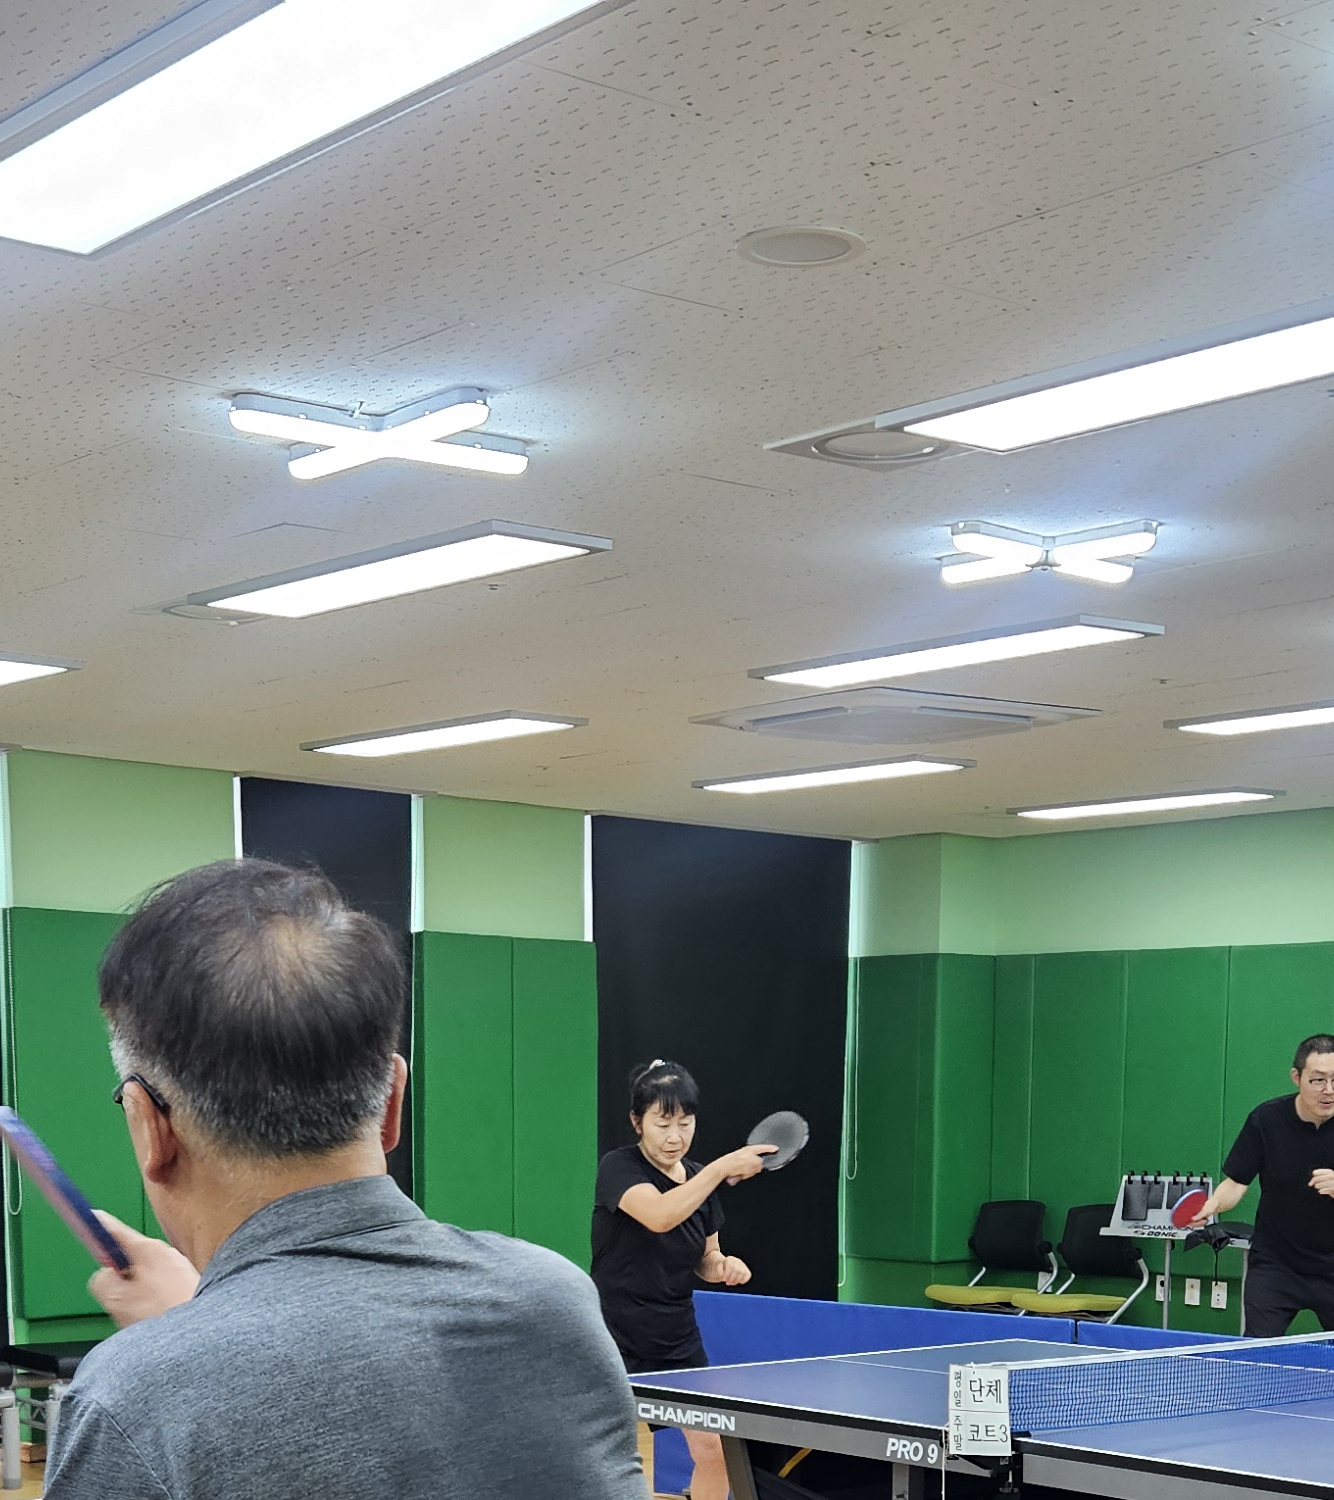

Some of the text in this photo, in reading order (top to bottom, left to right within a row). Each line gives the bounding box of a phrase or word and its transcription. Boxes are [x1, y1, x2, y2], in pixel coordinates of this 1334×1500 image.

[953, 1370, 962, 1408] 평일
[969, 1378, 1002, 1404] 단체
[637, 1403, 736, 1431] CHAMPION
[953, 1415, 963, 1451] 주말
[967, 1423, 1008, 1444] 코트3
[886, 1437, 939, 1464] PRO 9
